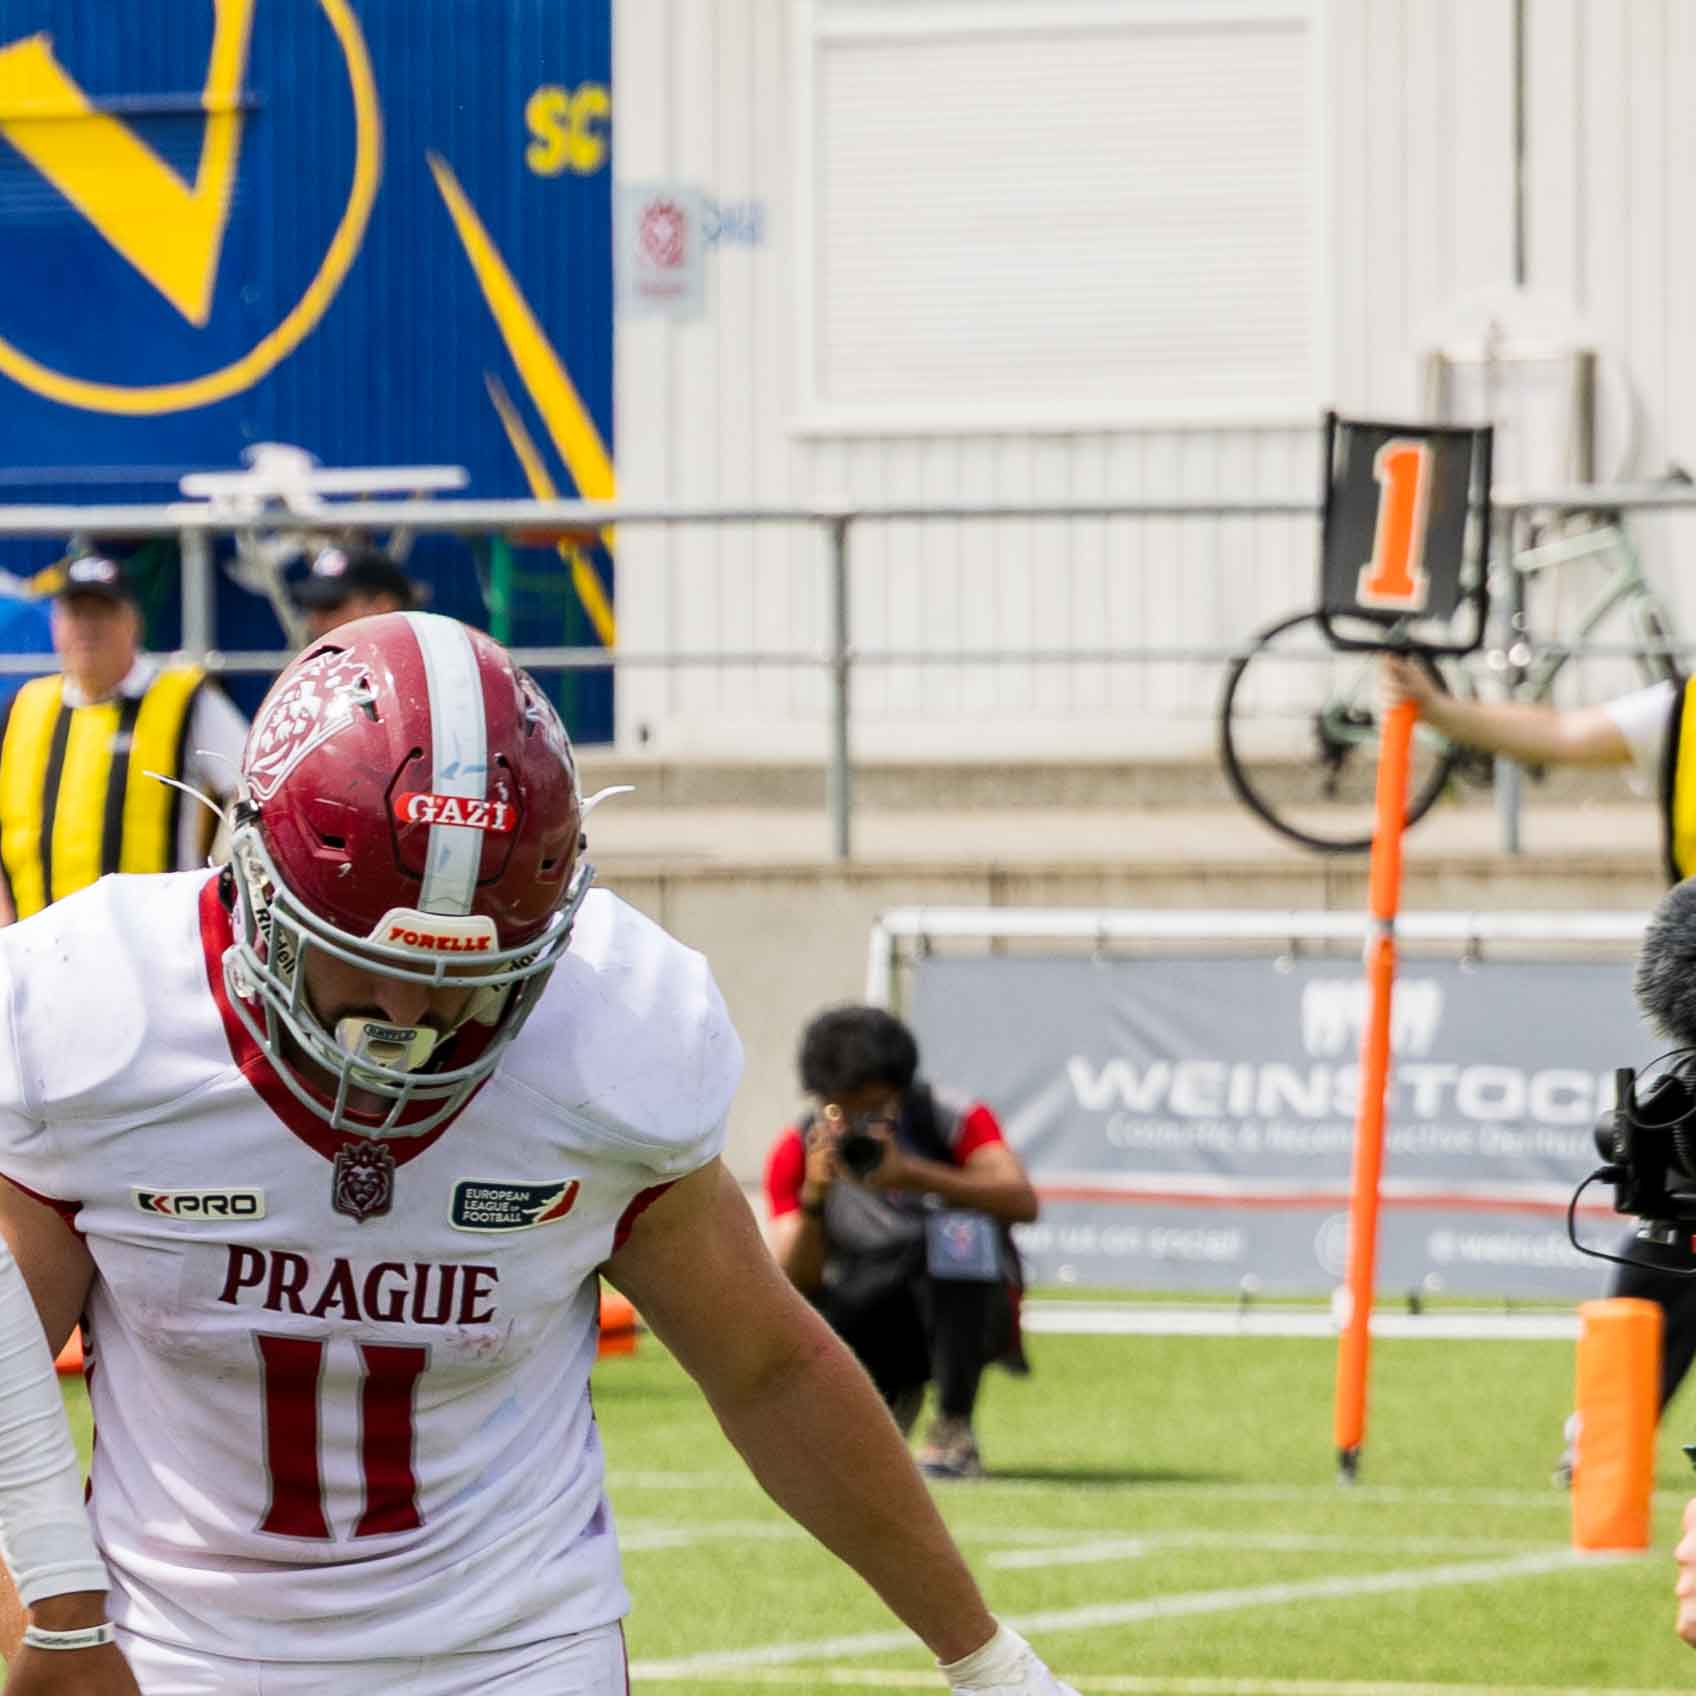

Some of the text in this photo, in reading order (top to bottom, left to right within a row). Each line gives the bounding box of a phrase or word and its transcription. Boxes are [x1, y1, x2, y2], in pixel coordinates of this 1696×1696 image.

[1355, 438, 1434, 611] 1
[407, 795, 509, 830] GAZI
[389, 926, 491, 951] FORELLE
[464, 1200, 510, 1211] LEAGUE
[465, 1188, 530, 1201] EUROPEAN
[462, 1211, 522, 1222] FOOTBALL
[217, 1243, 500, 1325] PRAGUE
[251, 1329, 433, 1543] 11
